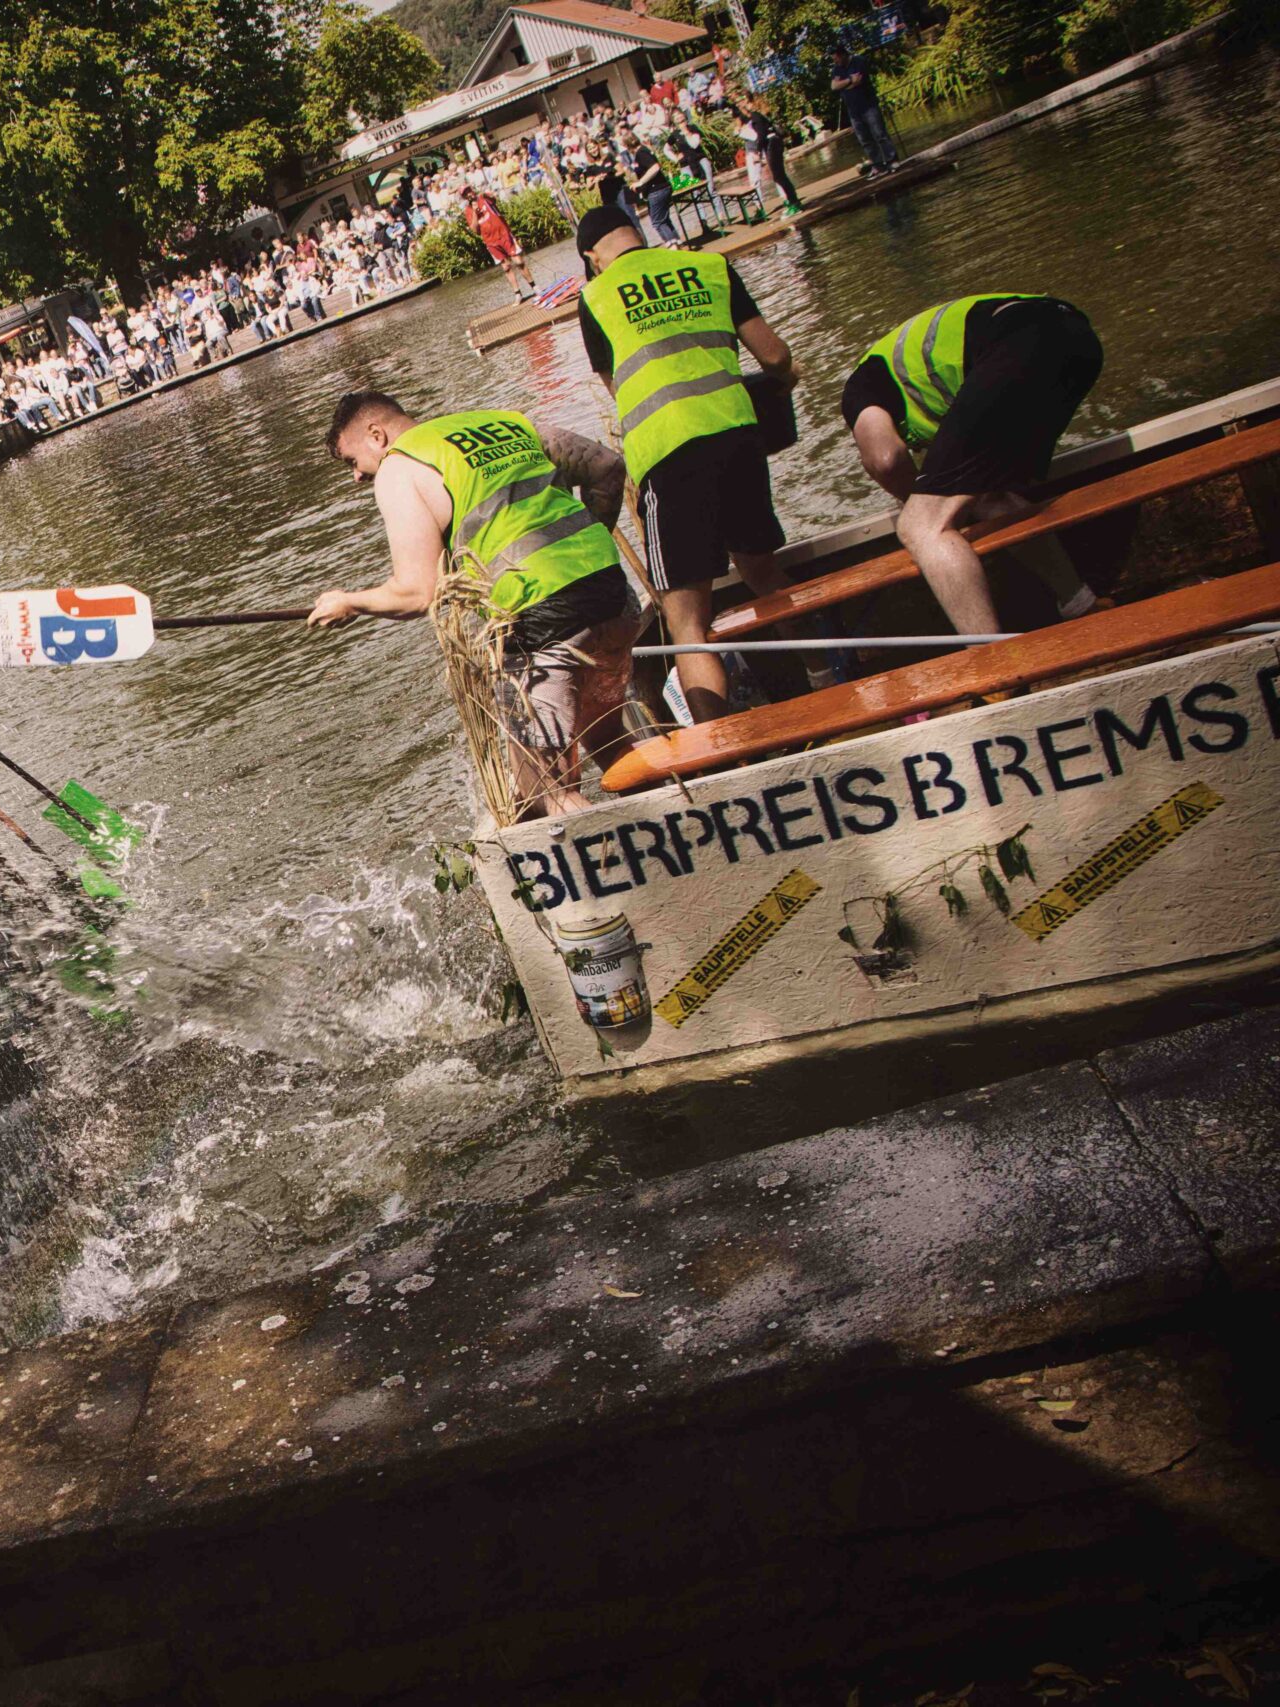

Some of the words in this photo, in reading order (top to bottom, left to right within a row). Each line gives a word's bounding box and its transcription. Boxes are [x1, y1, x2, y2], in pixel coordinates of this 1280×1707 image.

[467, 80, 505, 102] VELTINS
[373, 120, 408, 142] VELTINS
[617, 267, 705, 309] BIER
[626, 291, 711, 323] AKTIVISTEN
[636, 317, 667, 335] Heben
[684, 309, 713, 323] Kleben
[443, 421, 532, 455] BIER
[1062, 819, 1162, 897] SAUFSTELLE
[693, 911, 768, 985] SAUFSTELLE
